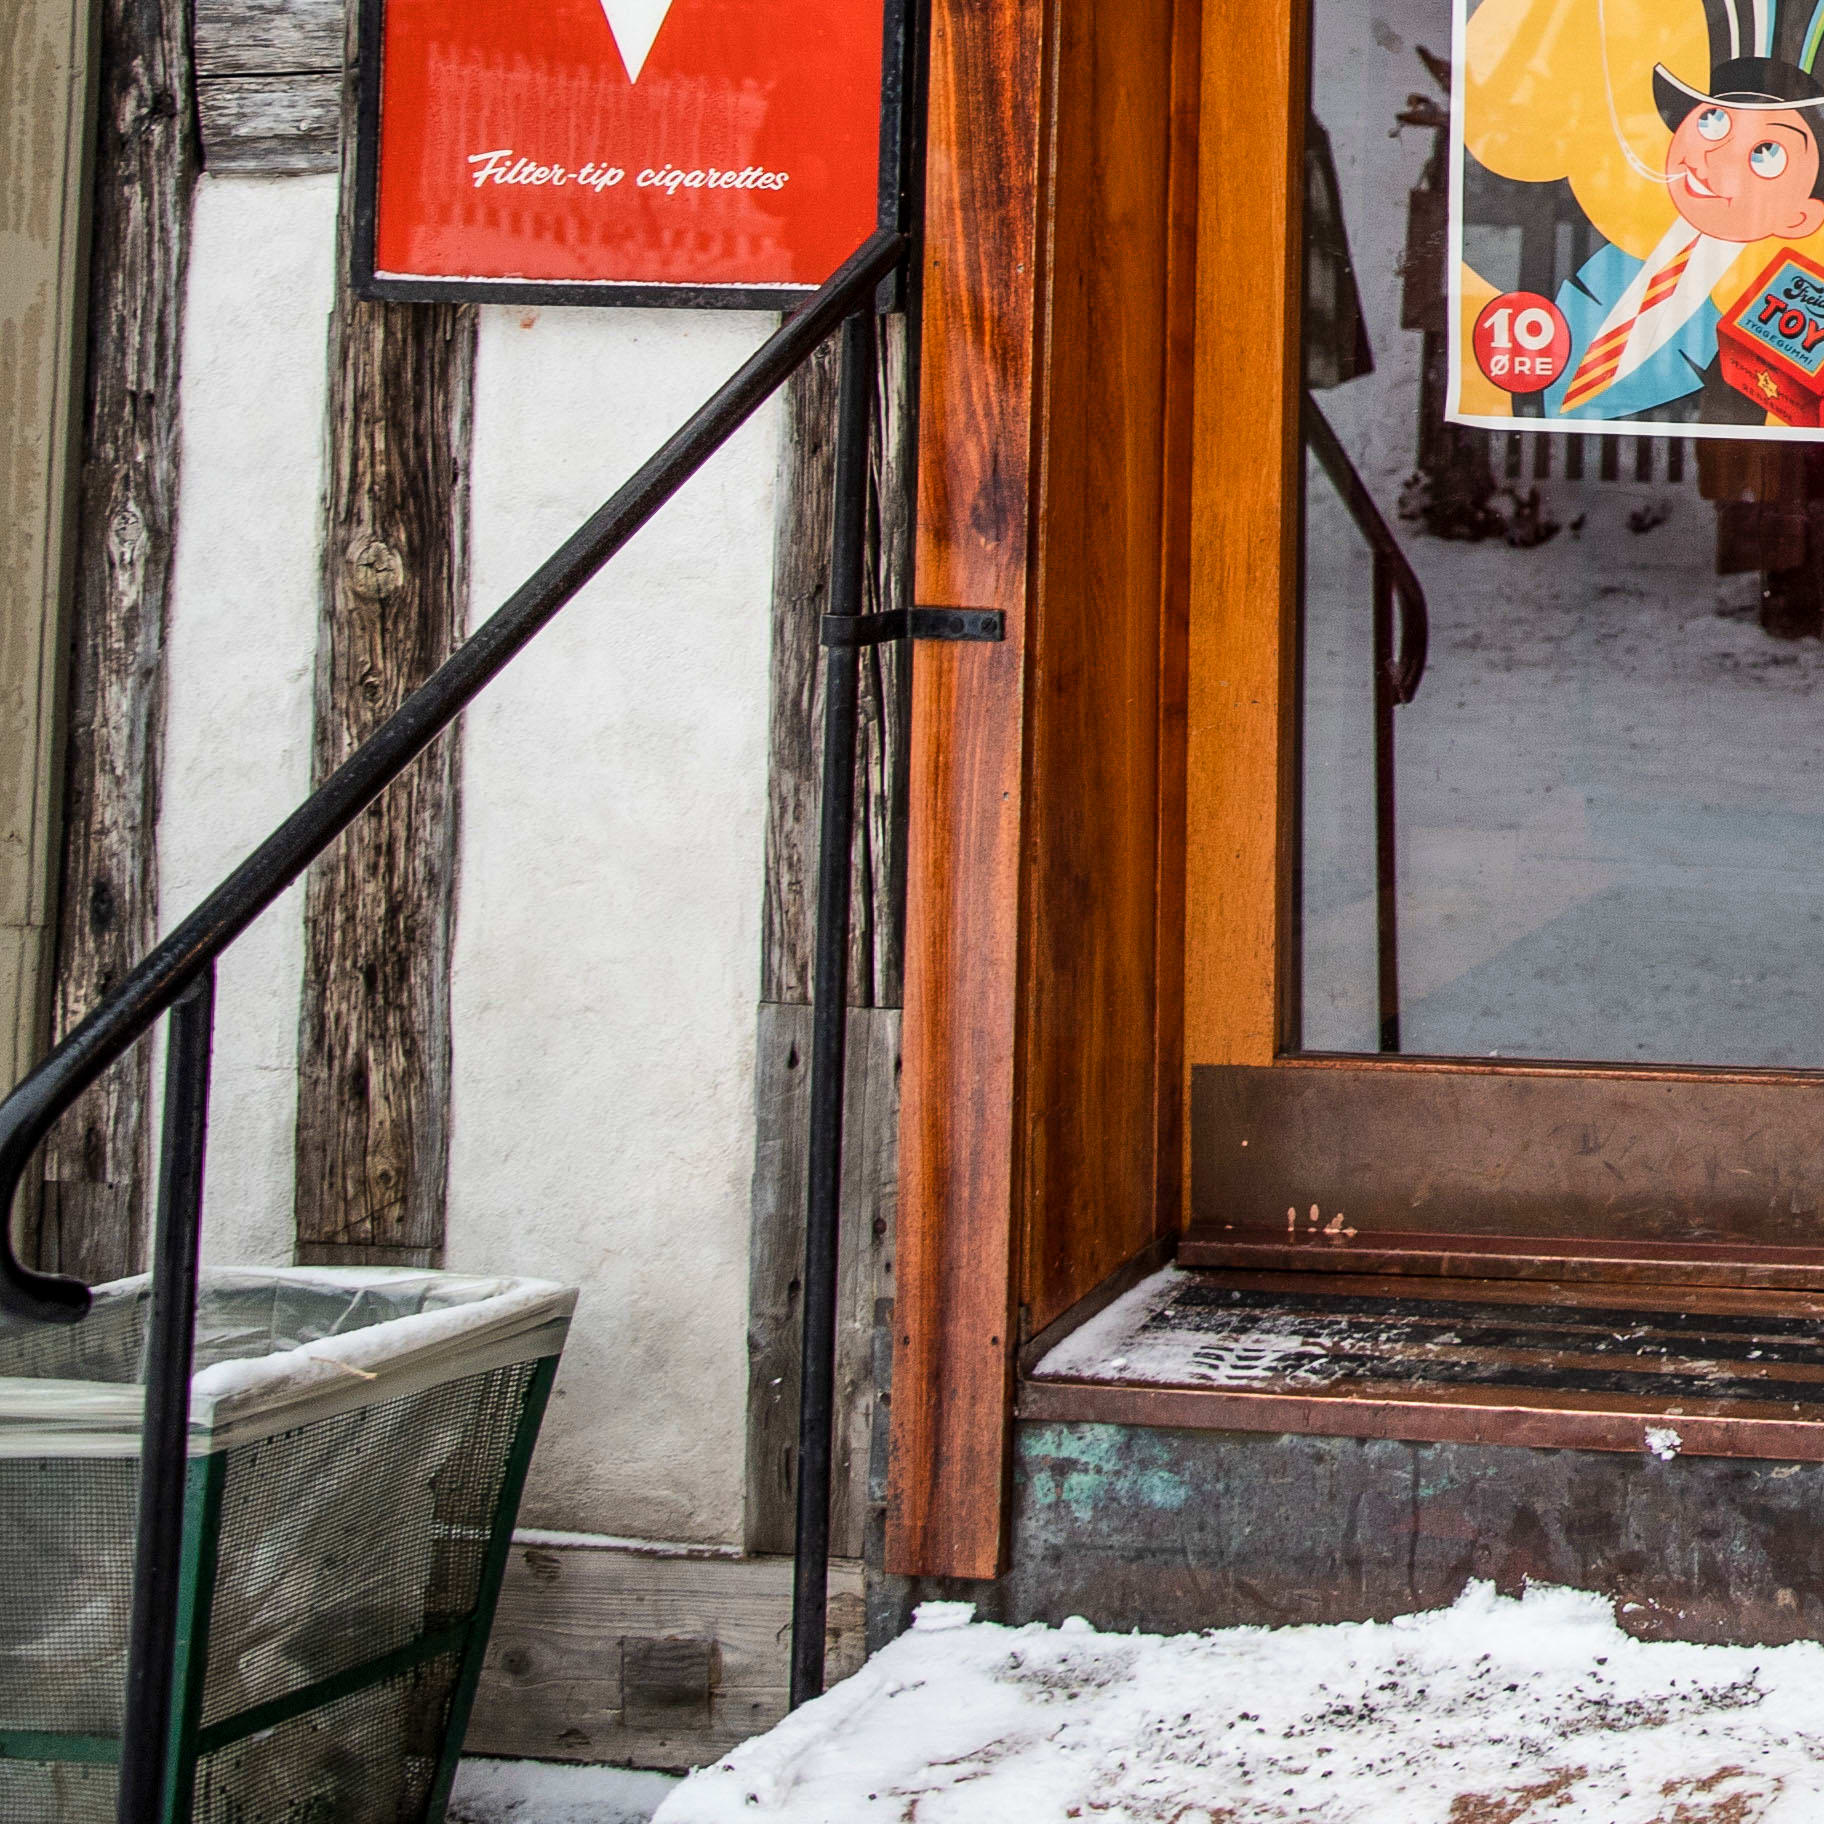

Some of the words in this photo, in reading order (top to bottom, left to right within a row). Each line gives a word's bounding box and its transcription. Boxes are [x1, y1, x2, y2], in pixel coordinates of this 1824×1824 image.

[468, 149, 624, 191] Filter-tip
[636, 161, 789, 195] cigarettes
[1482, 307, 1555, 350] 10
[1745, 318, 1814, 366] TYGGEGUMMI
[1490, 354, 1554, 378] ØRE
